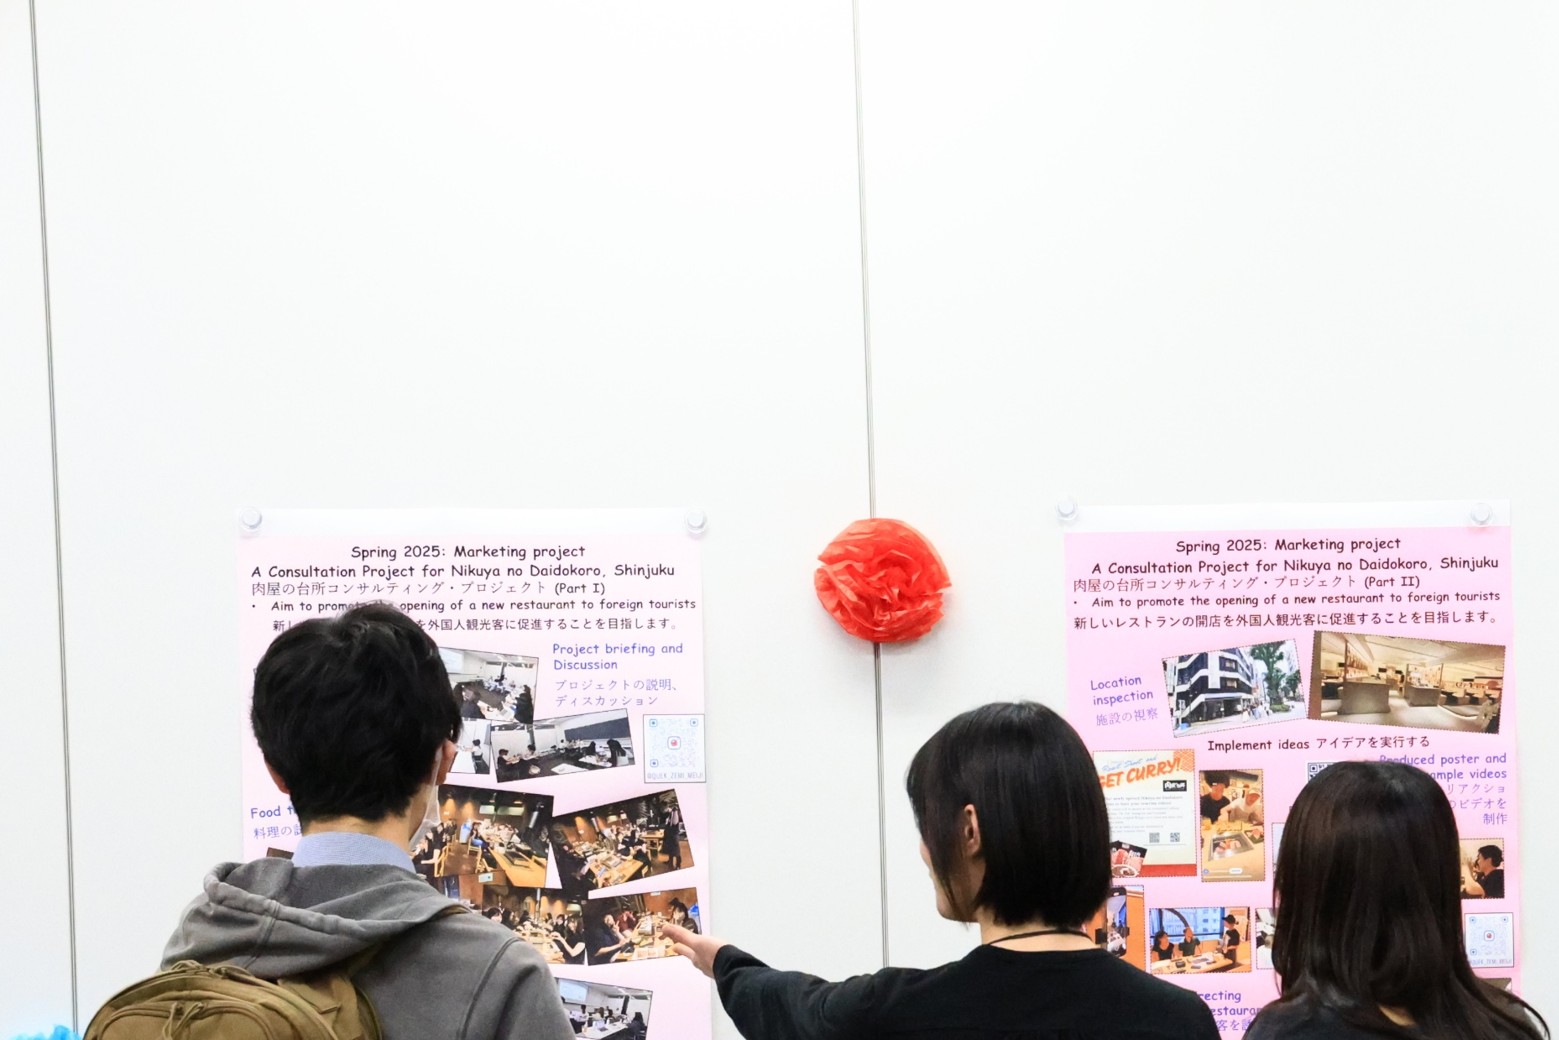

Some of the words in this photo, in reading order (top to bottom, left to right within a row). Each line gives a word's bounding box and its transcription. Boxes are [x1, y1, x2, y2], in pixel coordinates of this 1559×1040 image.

[351, 546, 397, 561] Spring
[404, 545, 446, 558] 2025:
[453, 545, 526, 560] Marketing
[533, 545, 586, 561] project
[1176, 541, 1220, 555] Spring
[1226, 539, 1267, 552] 2025:
[1275, 538, 1345, 553] Marketing
[1351, 538, 1401, 553] project
[251, 566, 261, 578] A
[268, 565, 356, 577] Consultation
[362, 565, 415, 581] Project
[422, 565, 444, 577] for
[451, 564, 500, 580] Nikuya
[507, 568, 523, 576] no
[530, 564, 606, 578] Daidokoro,
[614, 563, 675, 579] Shinjuku
[1091, 563, 1102, 574] A
[1108, 562, 1193, 574] Consultation
[1198, 561, 1250, 576] Project
[1255, 560, 1278, 573] for
[1284, 559, 1331, 574] Nikuya
[1337, 562, 1353, 570] no
[1359, 558, 1433, 571] Daidokoro,
[1440, 556, 1499, 572] Shinjuku
[554, 582, 587, 595] (Part
[592, 582, 605, 595] I)
[1364, 576, 1395, 589] (Part
[1400, 576, 1420, 588] II)
[271, 602, 294, 611] Aim
[299, 602, 312, 611] to
[400, 601, 445, 613] opening
[450, 600, 463, 611] of
[481, 602, 505, 610] new
[510, 600, 575, 610] restaurant
[582, 600, 594, 609] to
[600, 598, 643, 612] foreign
[649, 599, 696, 609] tourists
[1092, 597, 1114, 607] Aim
[1119, 597, 1132, 607] to
[1137, 597, 1184, 609] promote
[1190, 596, 1210, 606] the
[1215, 596, 1259, 608] opening
[1264, 594, 1276, 605] of
[1294, 595, 1316, 604] new
[1321, 594, 1384, 604] restaurant
[1390, 593, 1402, 603] to
[1407, 591, 1450, 604] foreign
[1454, 592, 1500, 602] tourists
[553, 643, 599, 657] Project
[605, 643, 656, 656] briefing
[661, 643, 683, 654] and
[553, 659, 618, 670] Discussion
[1090, 676, 1142, 691] Location
[1093, 690, 1153, 707] inspection
[1208, 740, 1272, 753] Implement
[1278, 739, 1310, 750] ideas
[1316, 736, 1430, 749] アイデアを実行する
[1440, 754, 1479, 767] poster
[1485, 752, 1507, 763] and
[1126, 757, 1181, 784] CURRY!
[1430, 769, 1464, 782] ample
[1469, 768, 1507, 779] videos
[250, 805, 281, 819] Food
[1483, 813, 1508, 825] 制作
